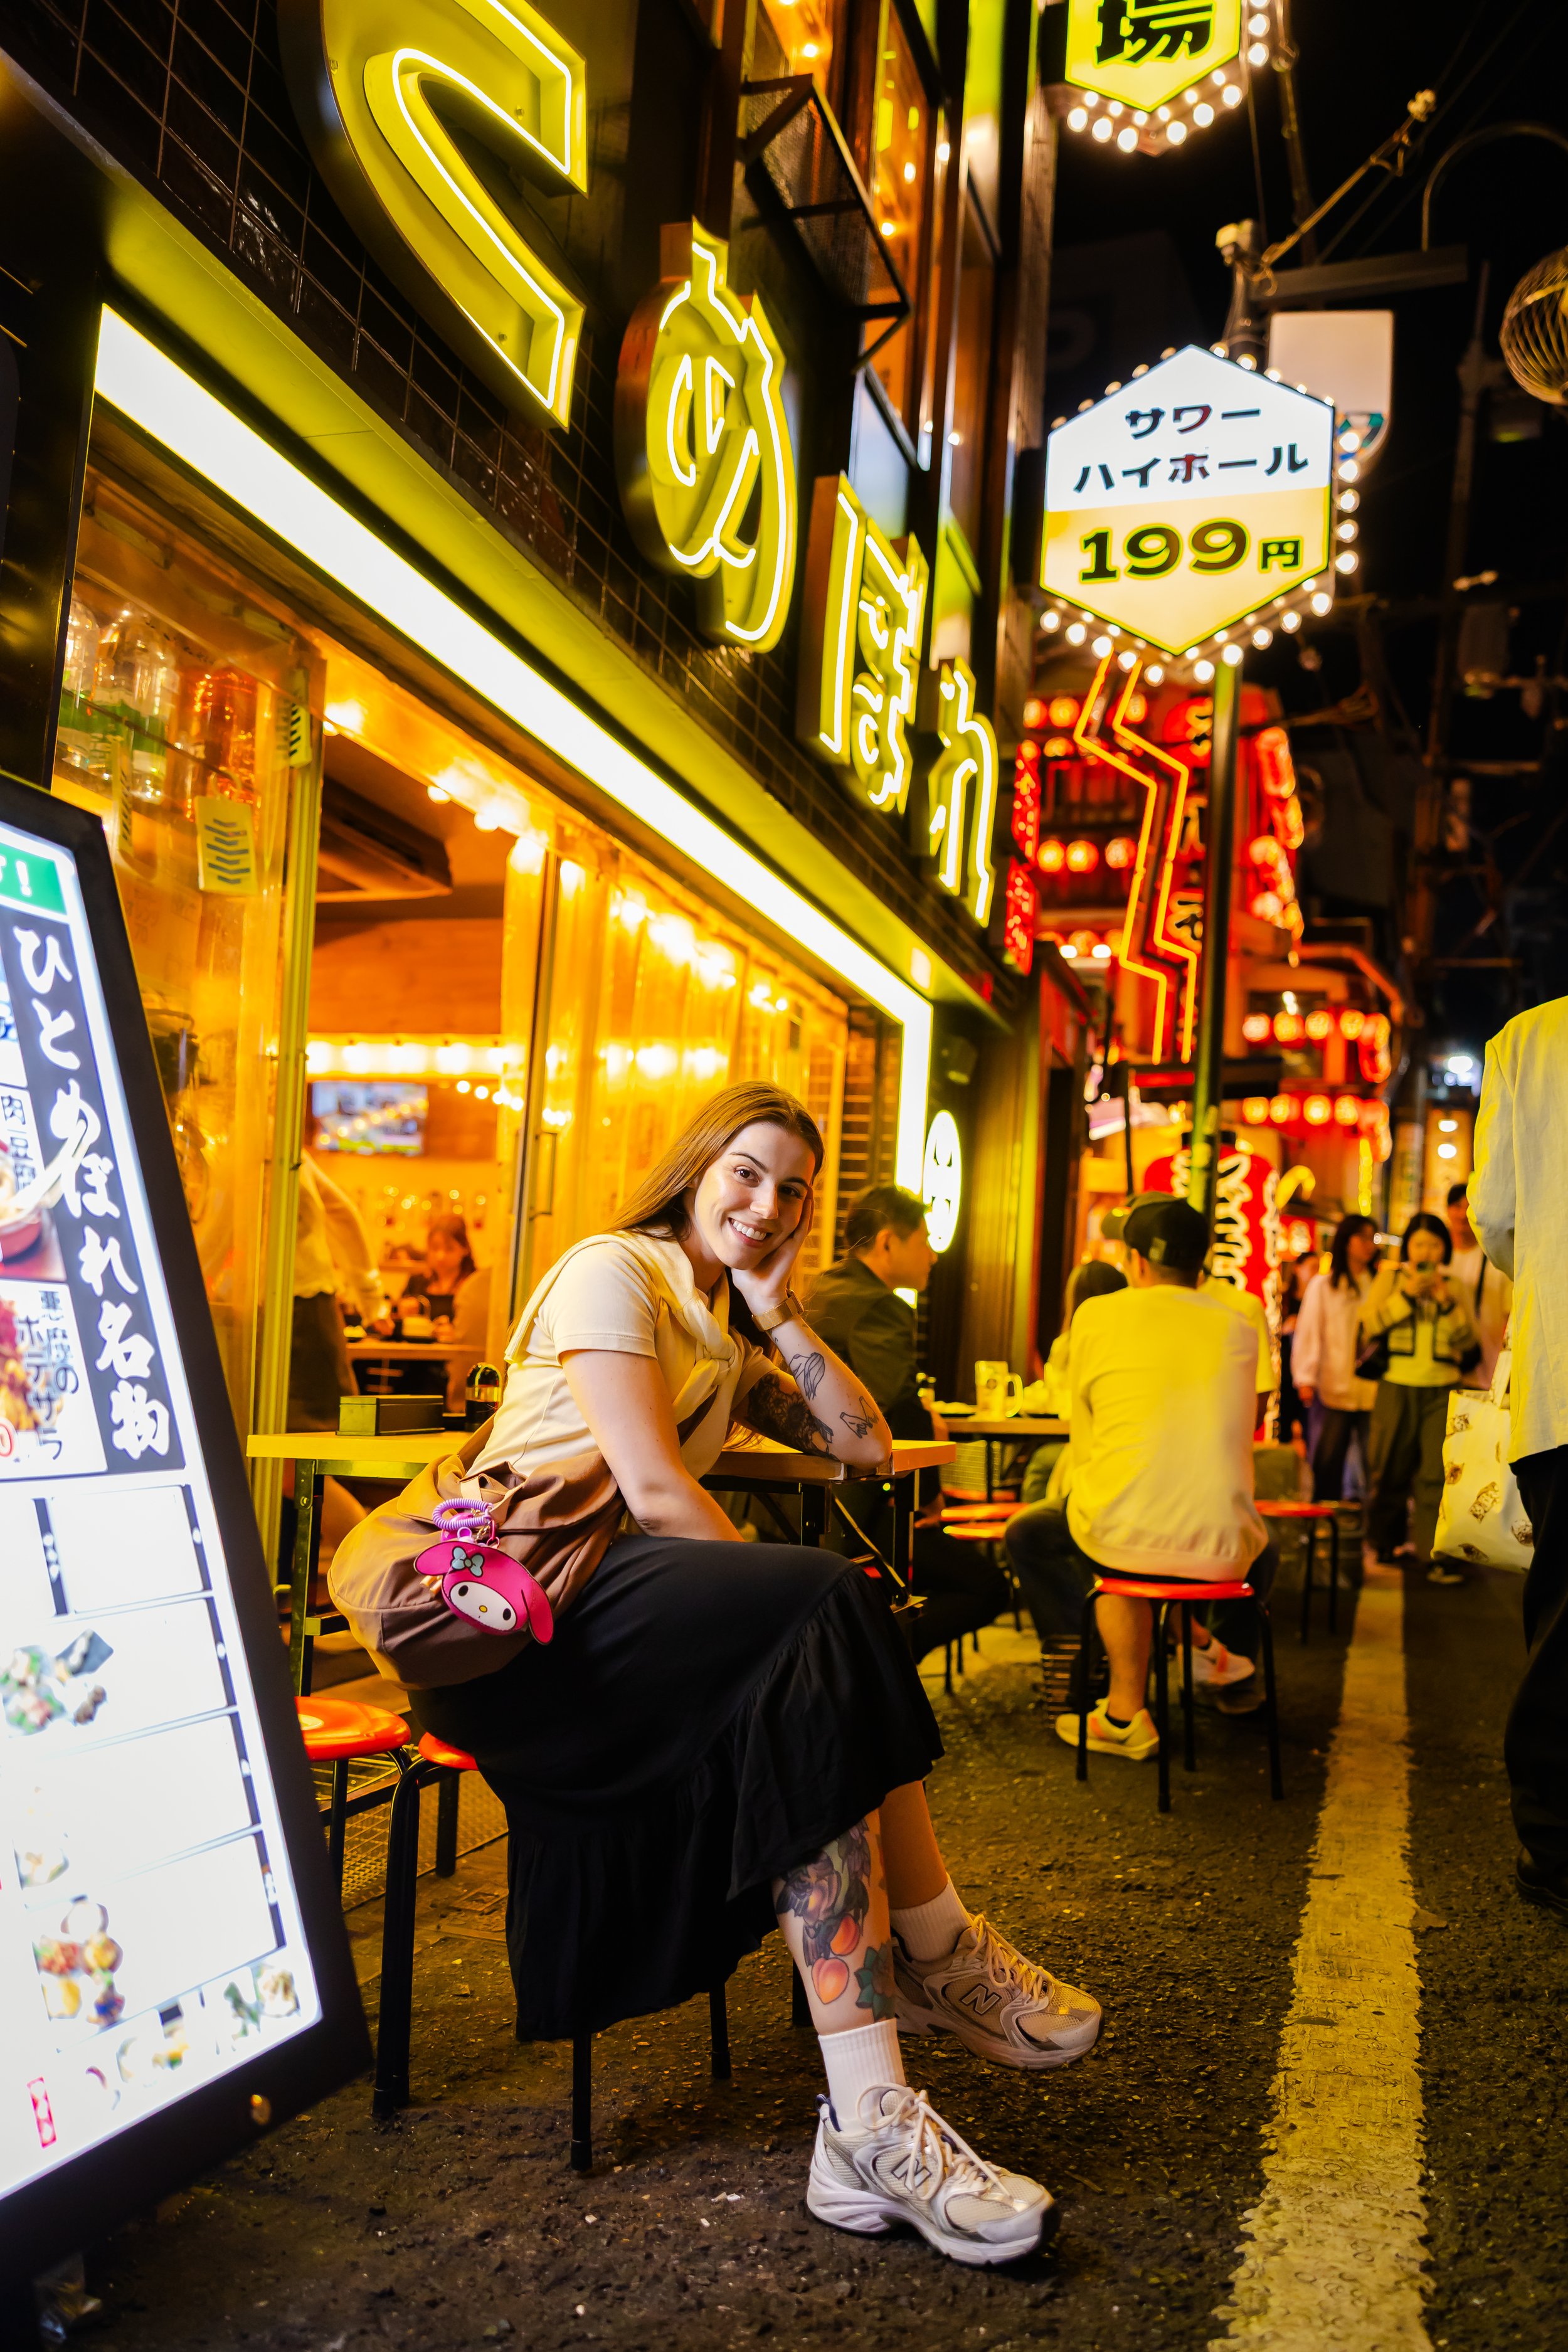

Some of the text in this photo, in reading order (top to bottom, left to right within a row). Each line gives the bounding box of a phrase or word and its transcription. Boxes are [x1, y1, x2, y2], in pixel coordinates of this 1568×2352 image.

[1125, 403, 1261, 440] サワー
[1080, 519, 1303, 582] 199円
[11, 925, 171, 1461] ひとめぼれ名物
[960, 1983, 1002, 2016] N
[891, 2153, 933, 2195] N
